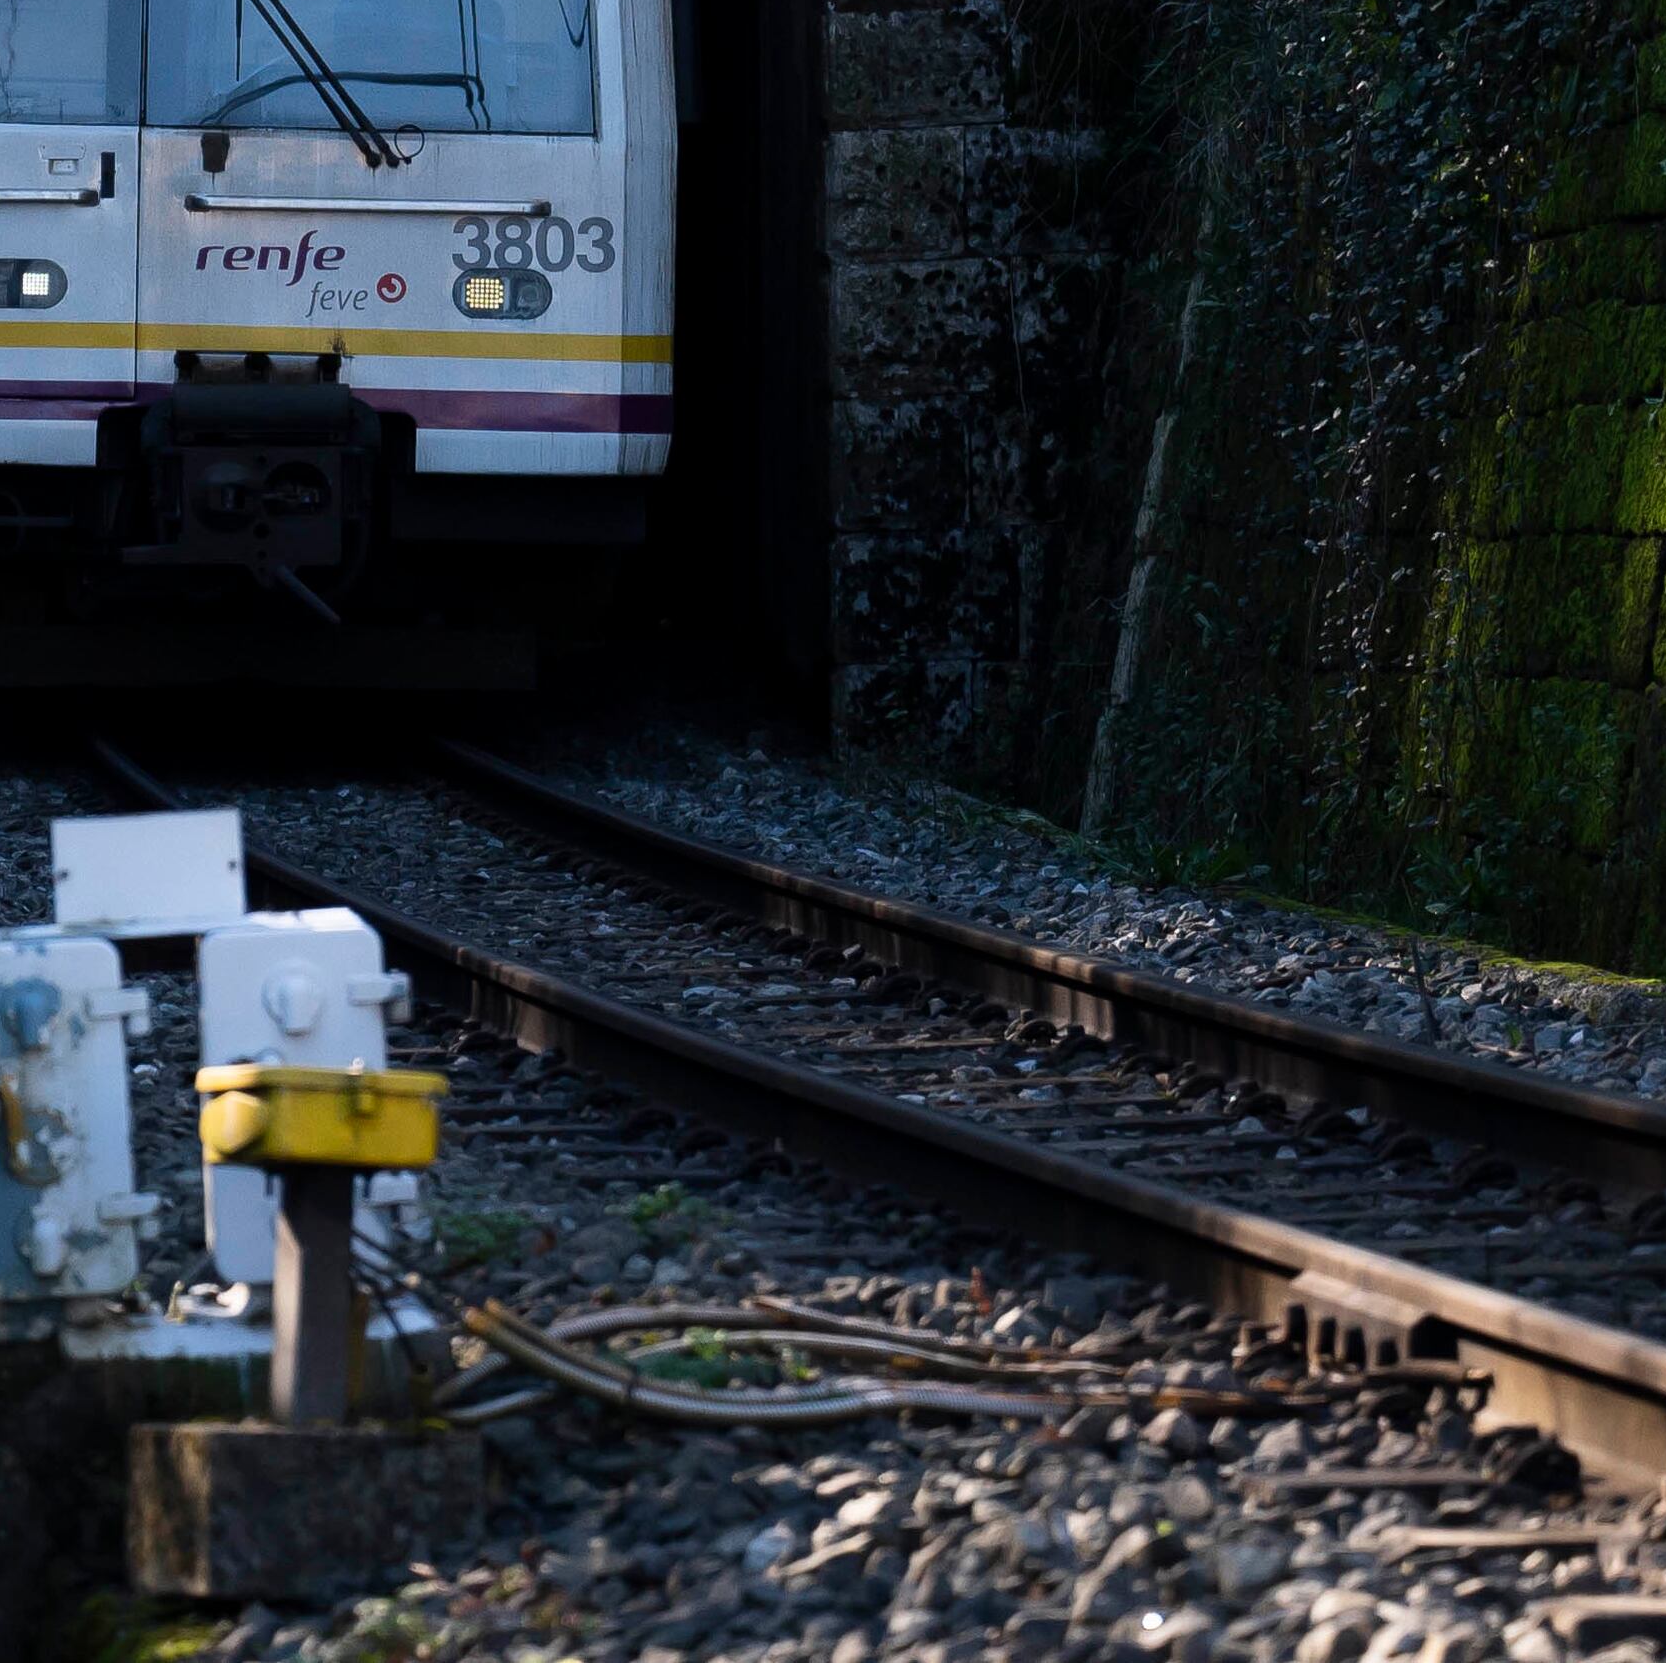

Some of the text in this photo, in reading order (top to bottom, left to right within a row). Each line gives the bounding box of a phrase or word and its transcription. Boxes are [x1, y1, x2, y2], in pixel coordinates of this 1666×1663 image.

[195, 229, 346, 287] renfe
[452, 216, 616, 273] 3803
[305, 281, 369, 319] feve
